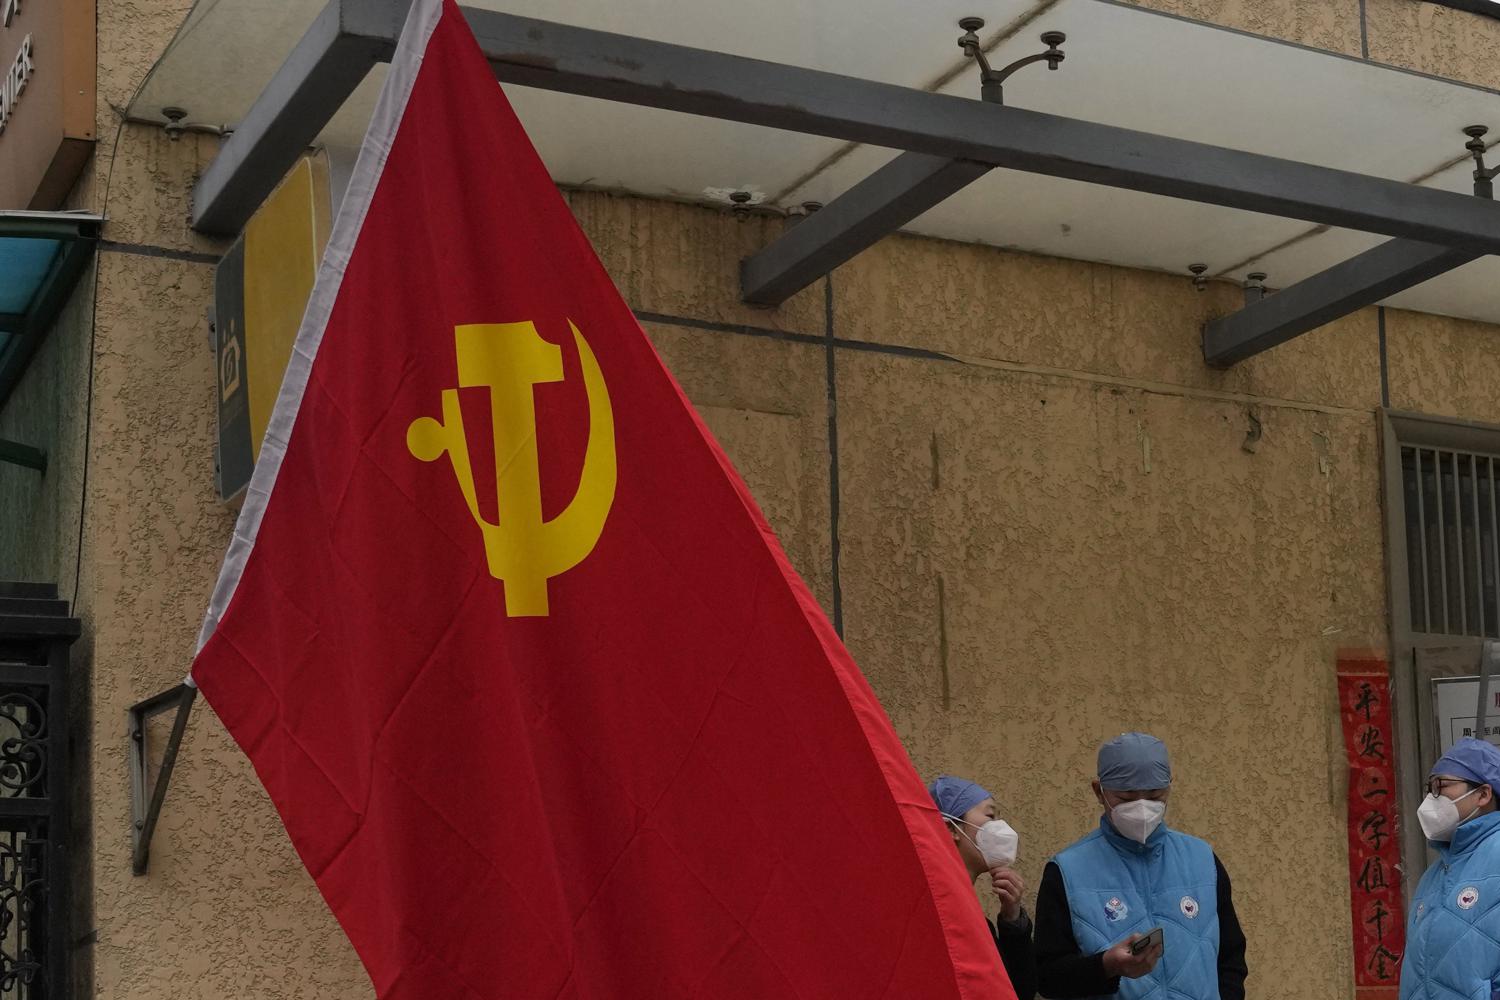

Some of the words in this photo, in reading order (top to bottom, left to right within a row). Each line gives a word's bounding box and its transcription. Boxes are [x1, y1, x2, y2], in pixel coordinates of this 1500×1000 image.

[1353, 682, 1398, 980] 平安二字值千金
